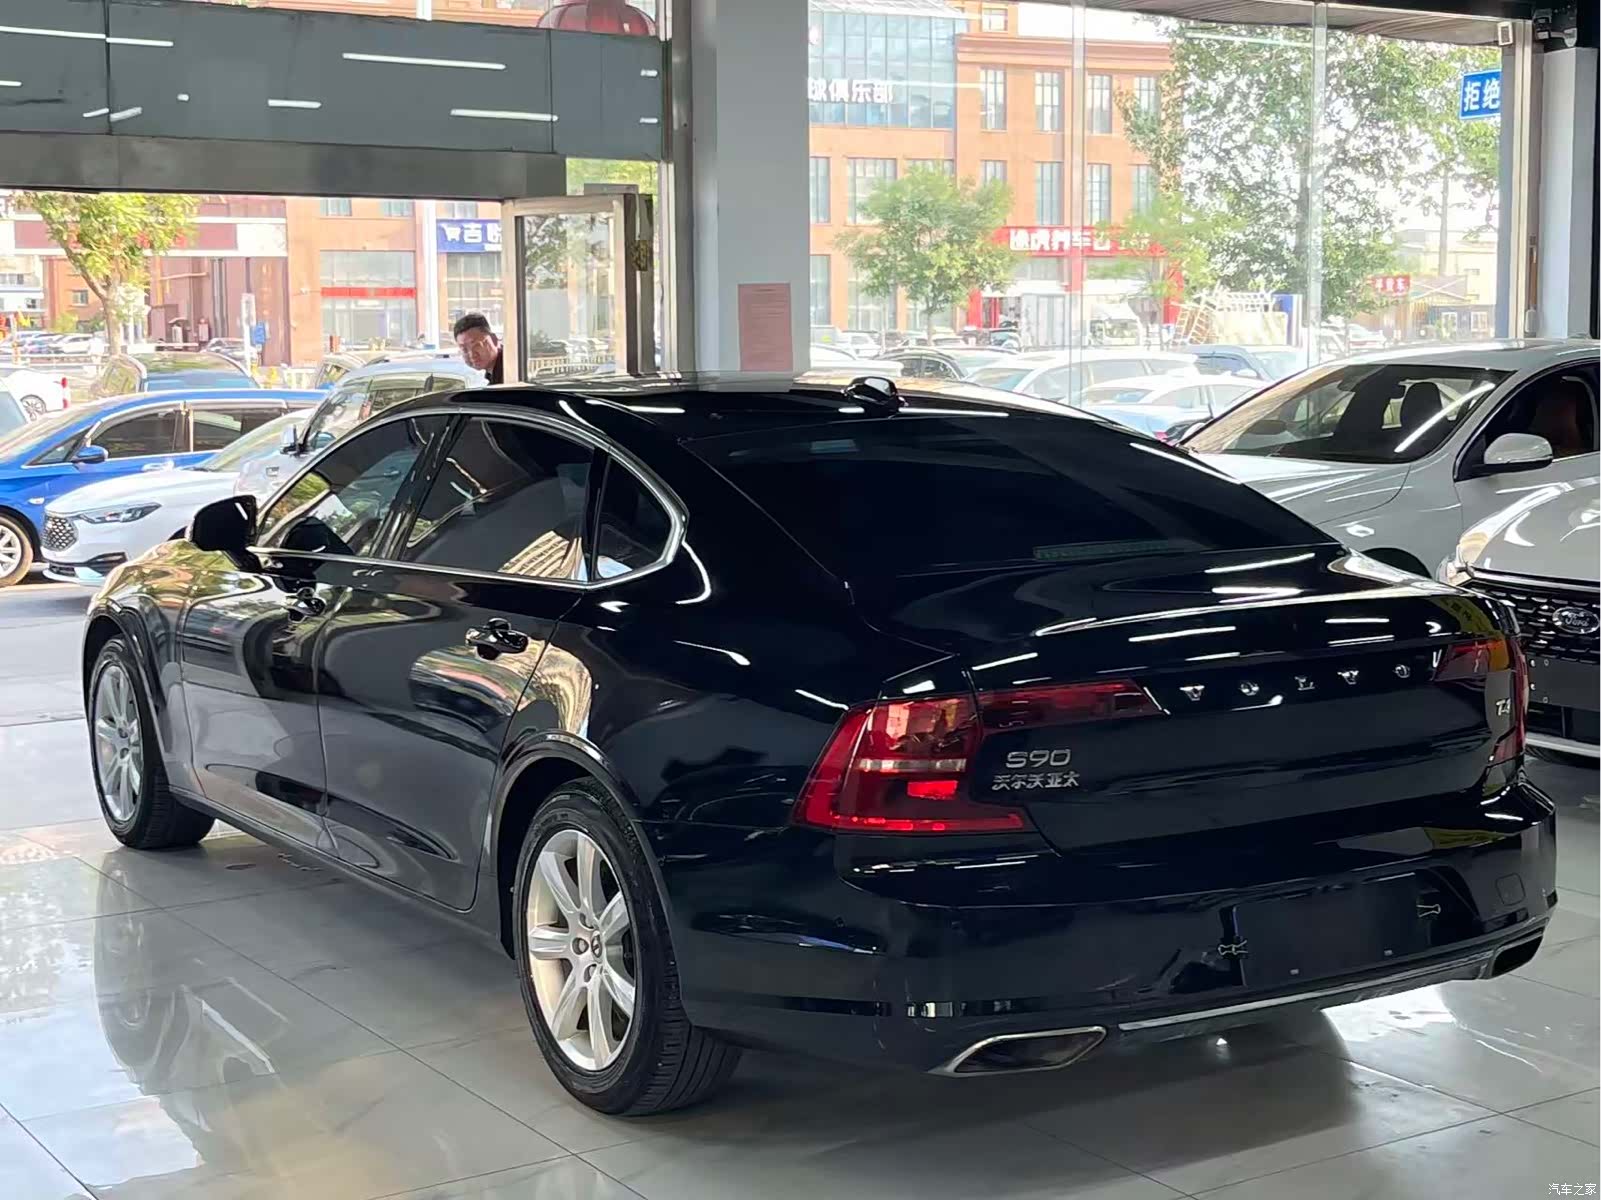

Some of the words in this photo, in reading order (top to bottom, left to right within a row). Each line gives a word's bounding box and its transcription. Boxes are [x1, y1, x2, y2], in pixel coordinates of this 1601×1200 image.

[1464, 77, 1500, 111] 拒绝
[1564, 611, 1590, 627] Ford
[1180, 664, 1411, 701] VOLVO
[1005, 748, 1071, 768] S90
[991, 770, 1081, 791] 沃尔沃亚太
